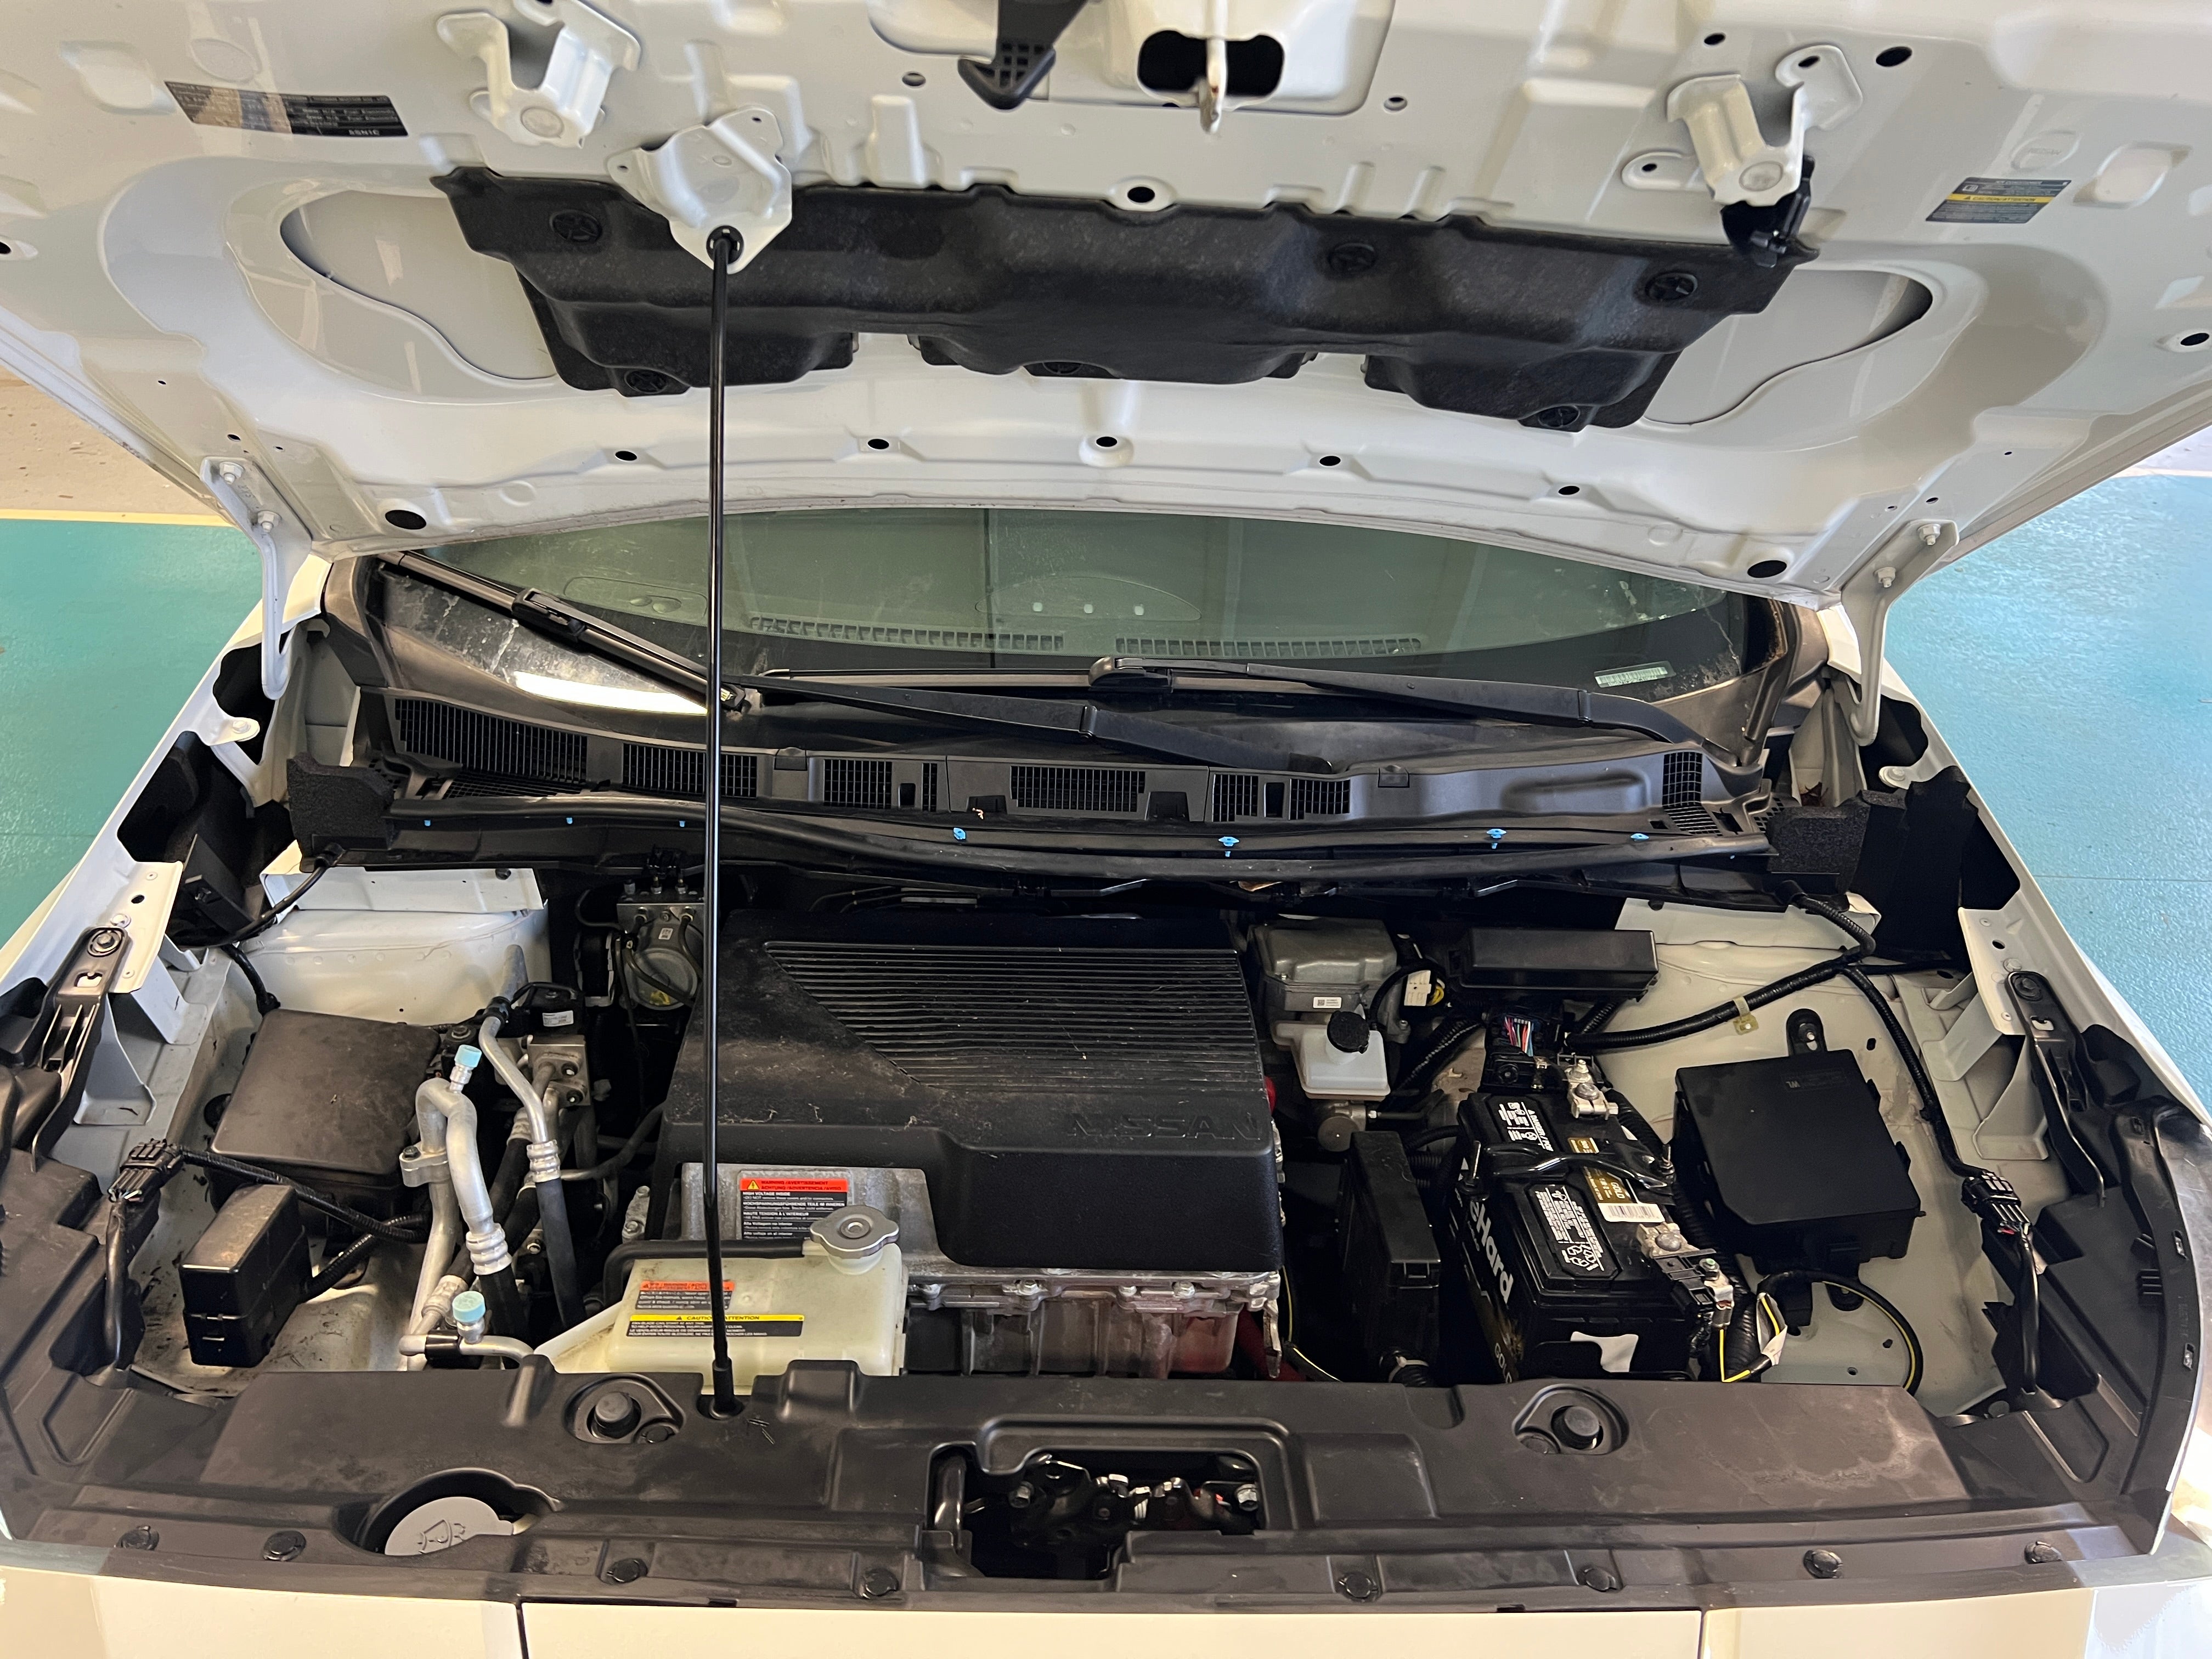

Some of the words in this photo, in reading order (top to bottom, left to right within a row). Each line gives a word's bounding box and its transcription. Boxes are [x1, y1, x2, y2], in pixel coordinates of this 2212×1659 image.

[1067, 1113, 1261, 1141] NISSAN
[1611, 1182, 1626, 1199] GOLD
[1470, 1200, 1514, 1305] eHard
